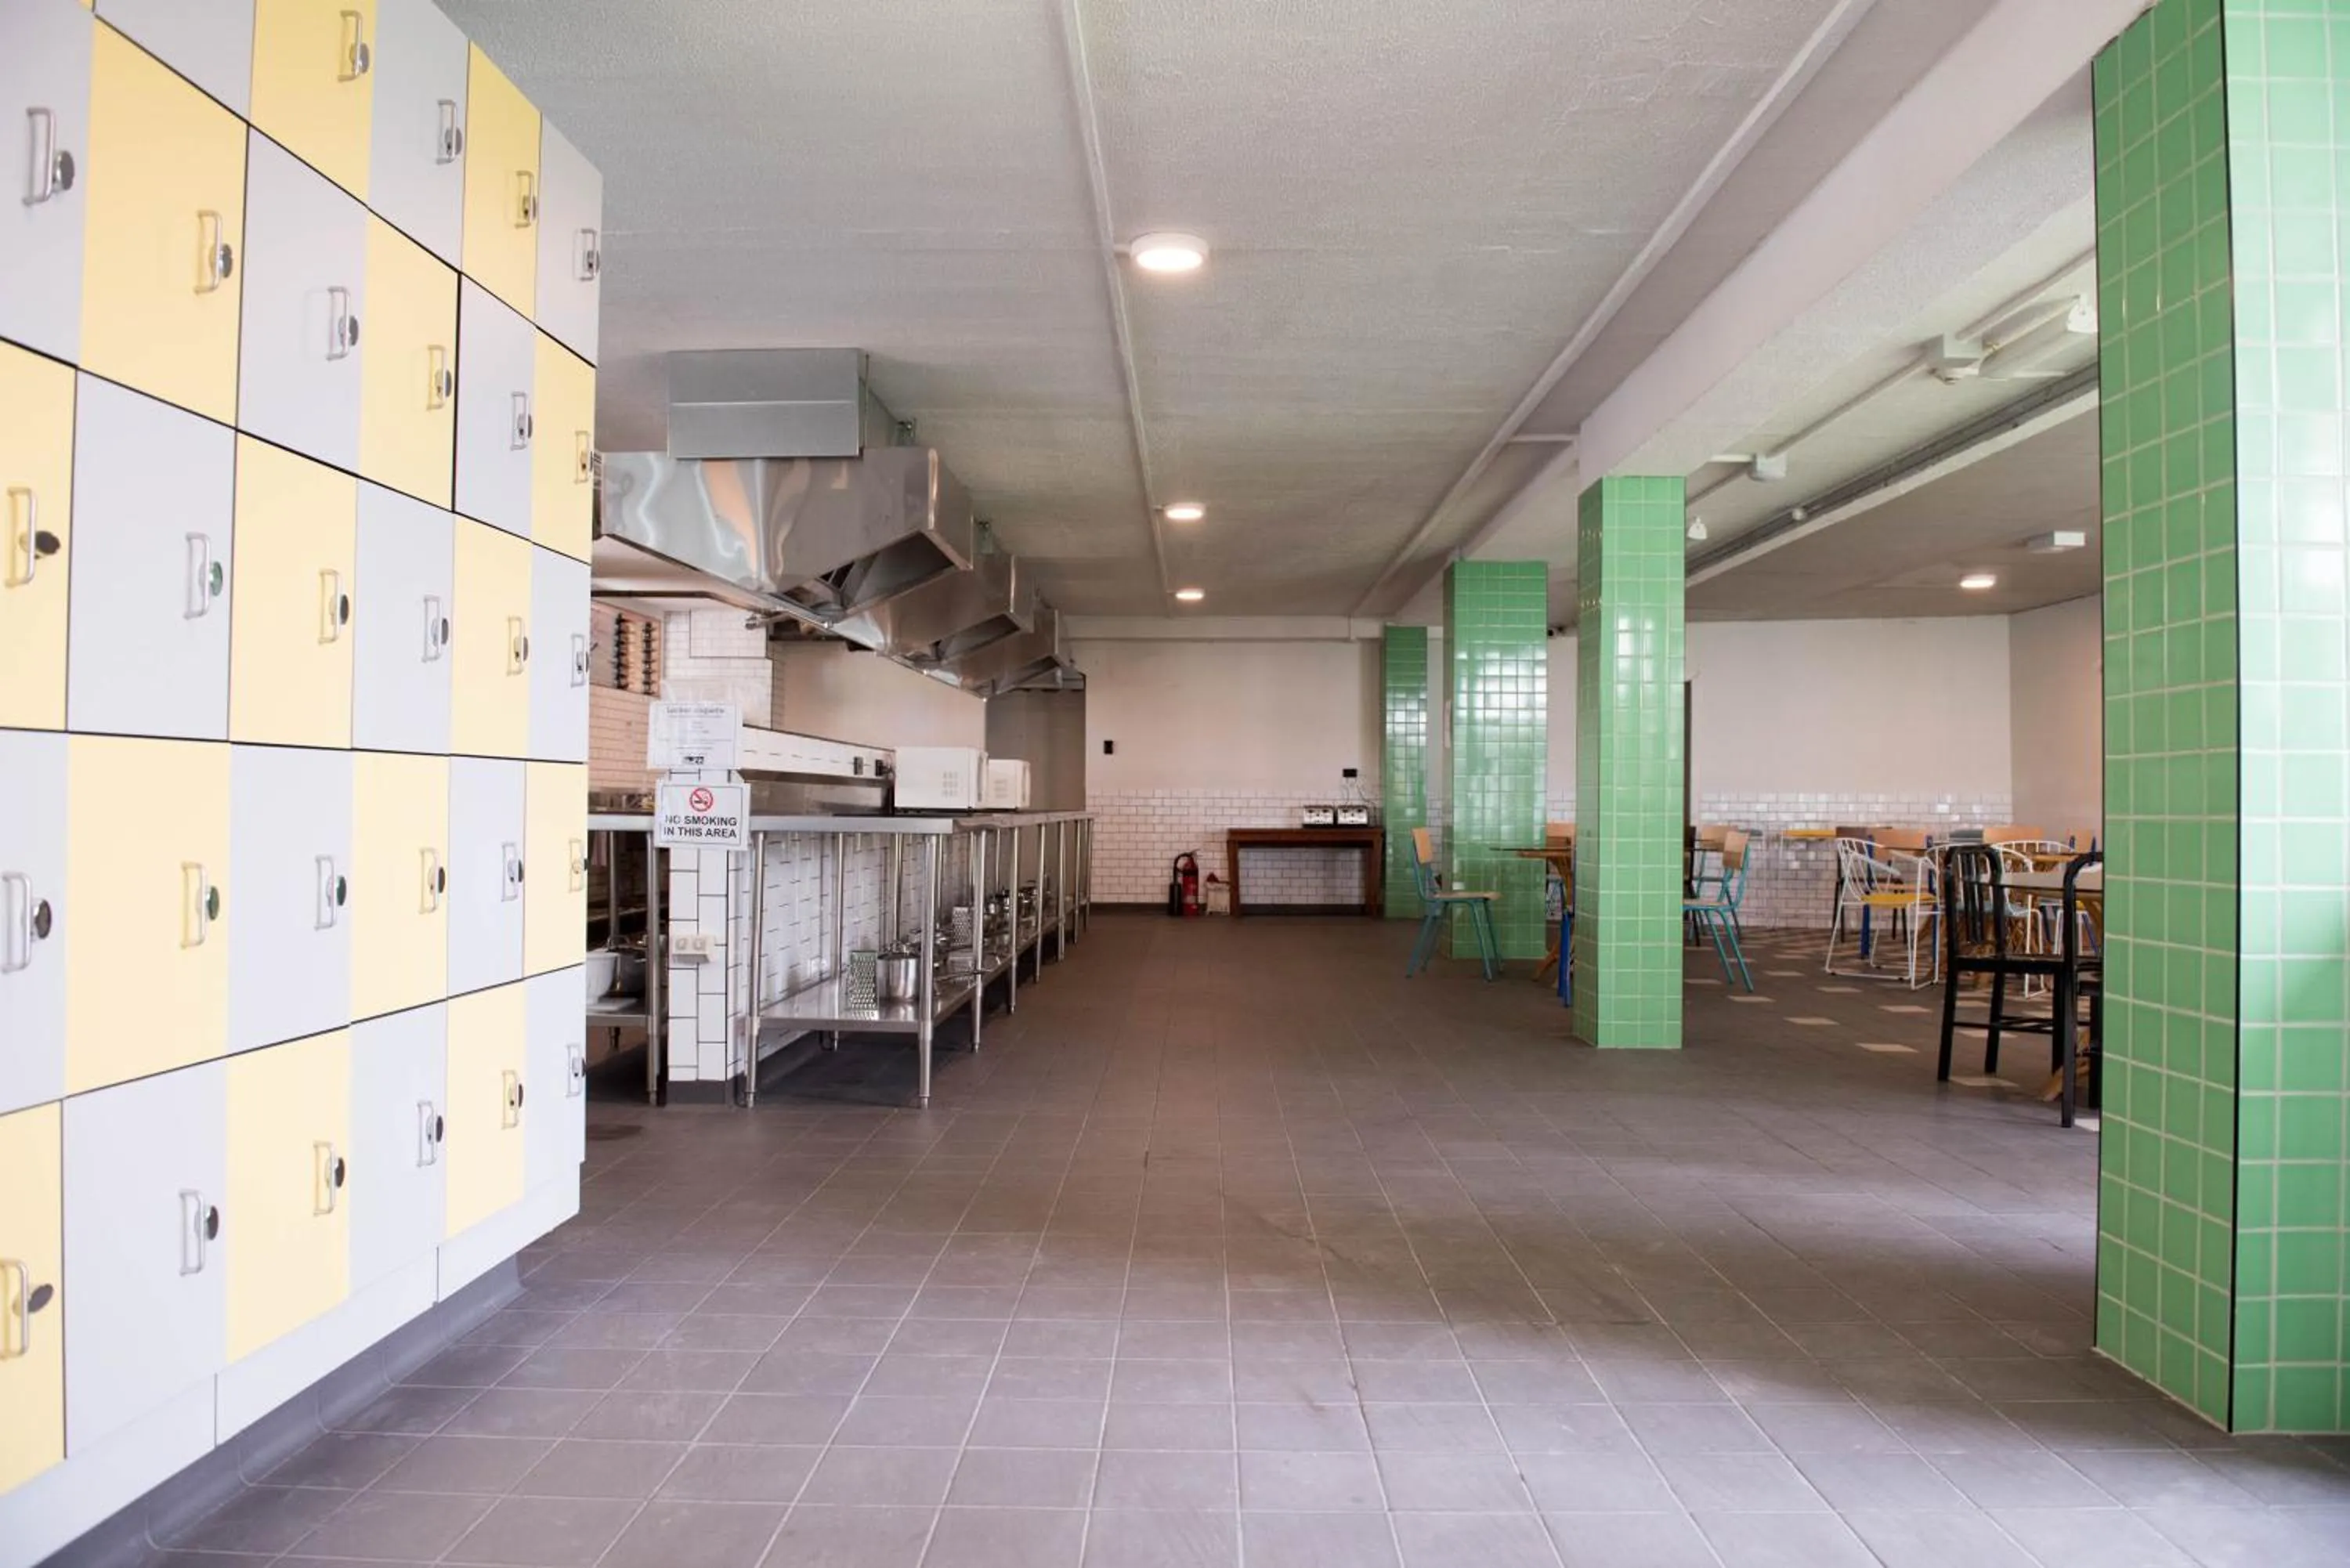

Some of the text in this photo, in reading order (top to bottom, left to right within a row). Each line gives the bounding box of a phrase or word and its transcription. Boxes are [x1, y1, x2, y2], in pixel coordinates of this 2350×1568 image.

[665, 815, 737, 826] NO SMOKING
[663, 826, 737, 839] IN THIS AREA
